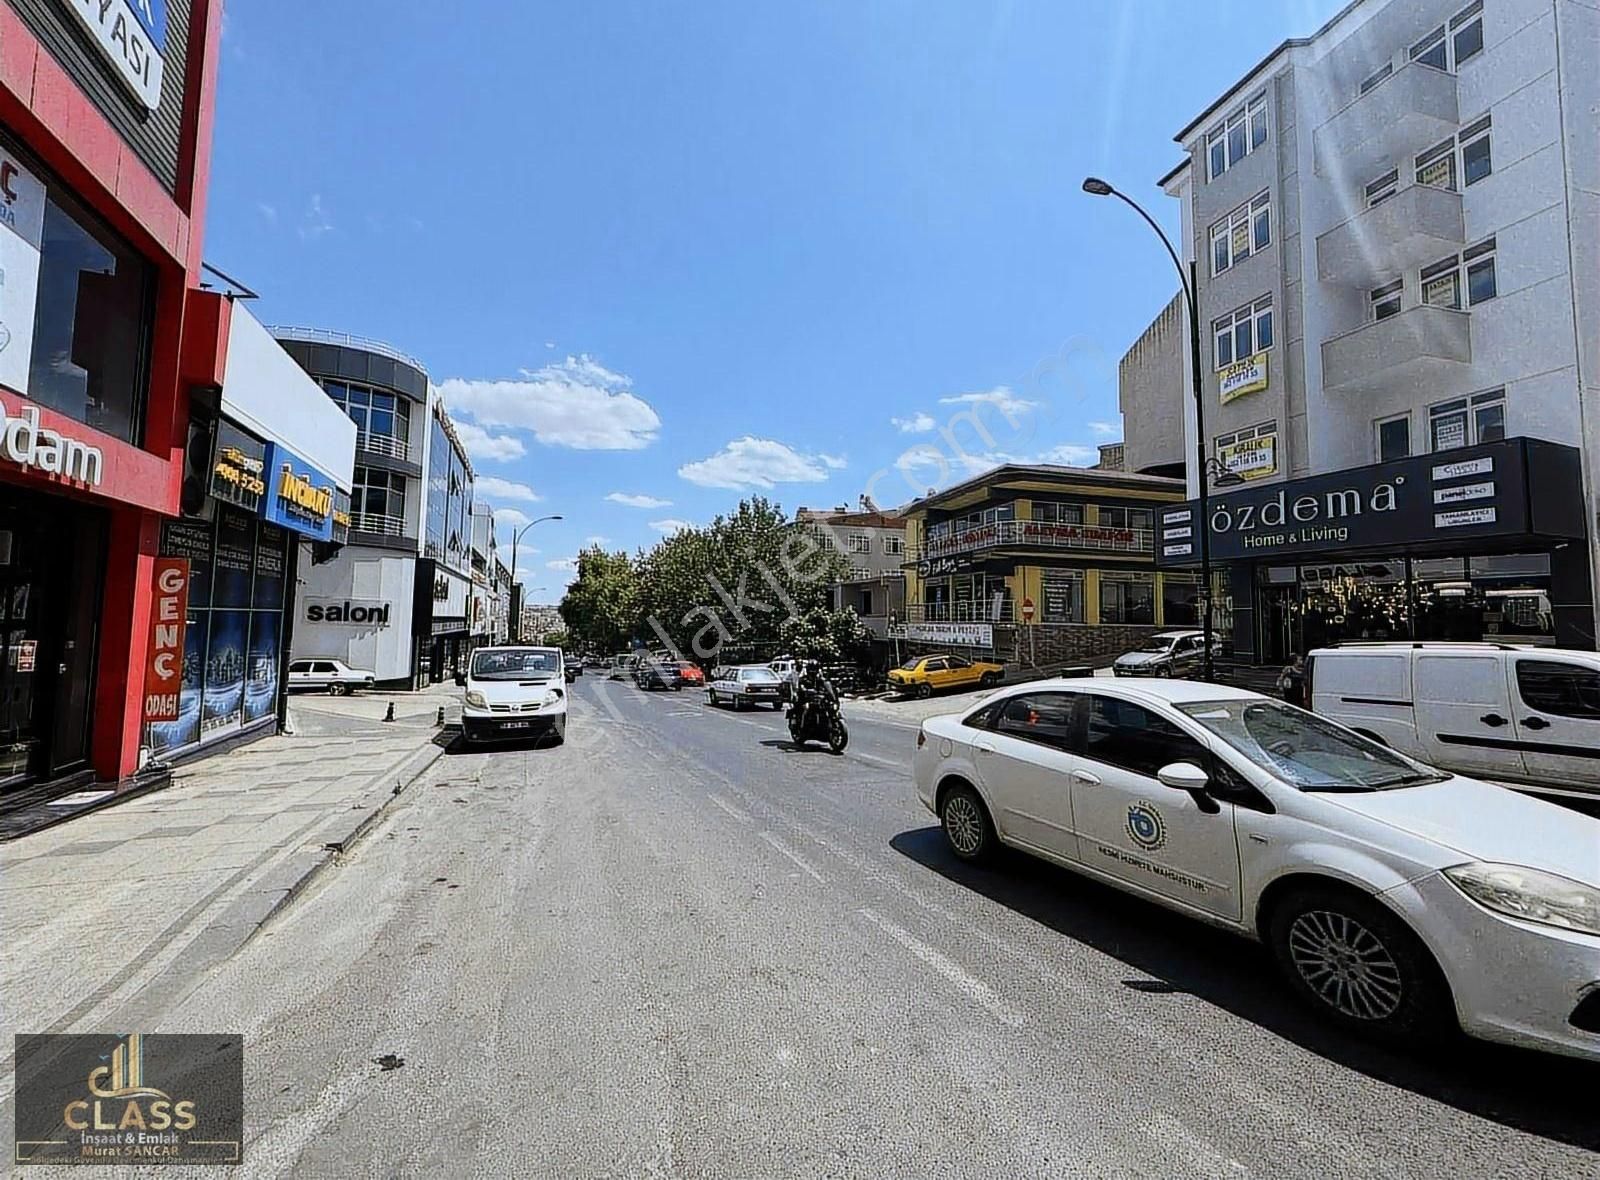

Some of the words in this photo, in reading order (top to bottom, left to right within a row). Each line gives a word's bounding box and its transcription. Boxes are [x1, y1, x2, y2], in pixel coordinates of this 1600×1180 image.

[1244, 533, 1285, 549] Home
[1288, 535, 1298, 544] &
[1302, 526, 1348, 542] Living
[154, 568, 184, 681] GENÇ
[145, 693, 177, 717] ODASI
